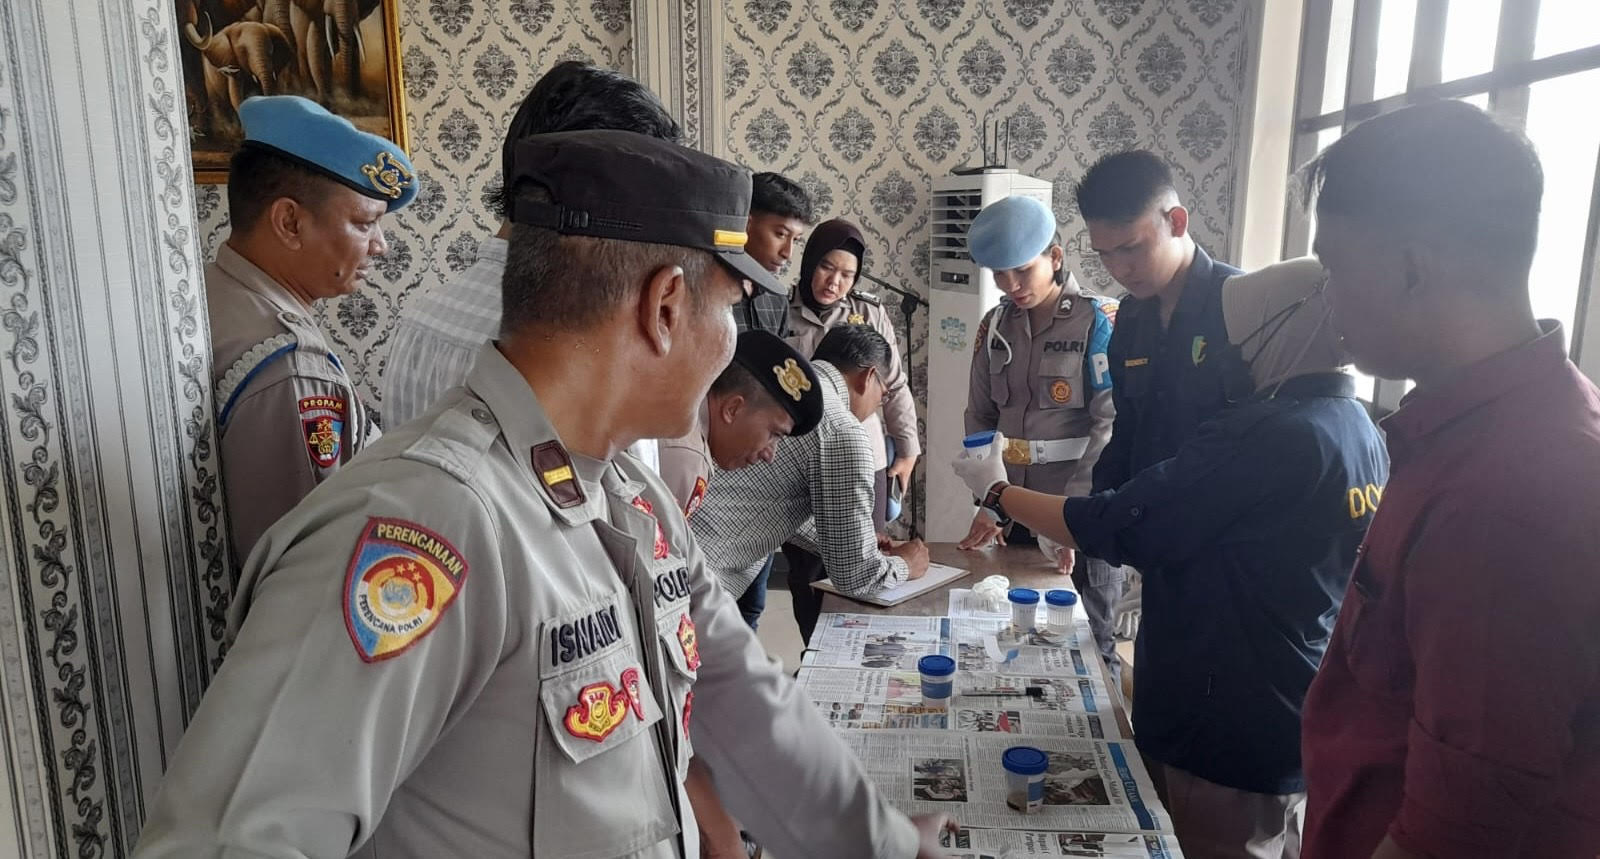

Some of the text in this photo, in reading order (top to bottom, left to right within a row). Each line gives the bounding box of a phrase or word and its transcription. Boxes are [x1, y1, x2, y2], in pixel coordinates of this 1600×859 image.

[1043, 340, 1084, 353] POLRI
[1091, 352, 1109, 385] P
[303, 399, 343, 410] PROPAM
[1348, 483, 1384, 519] DO
[377, 523, 464, 576] PERENCANAAN
[653, 566, 691, 608] POLR
[359, 593, 423, 634] PERENCANA POLRI
